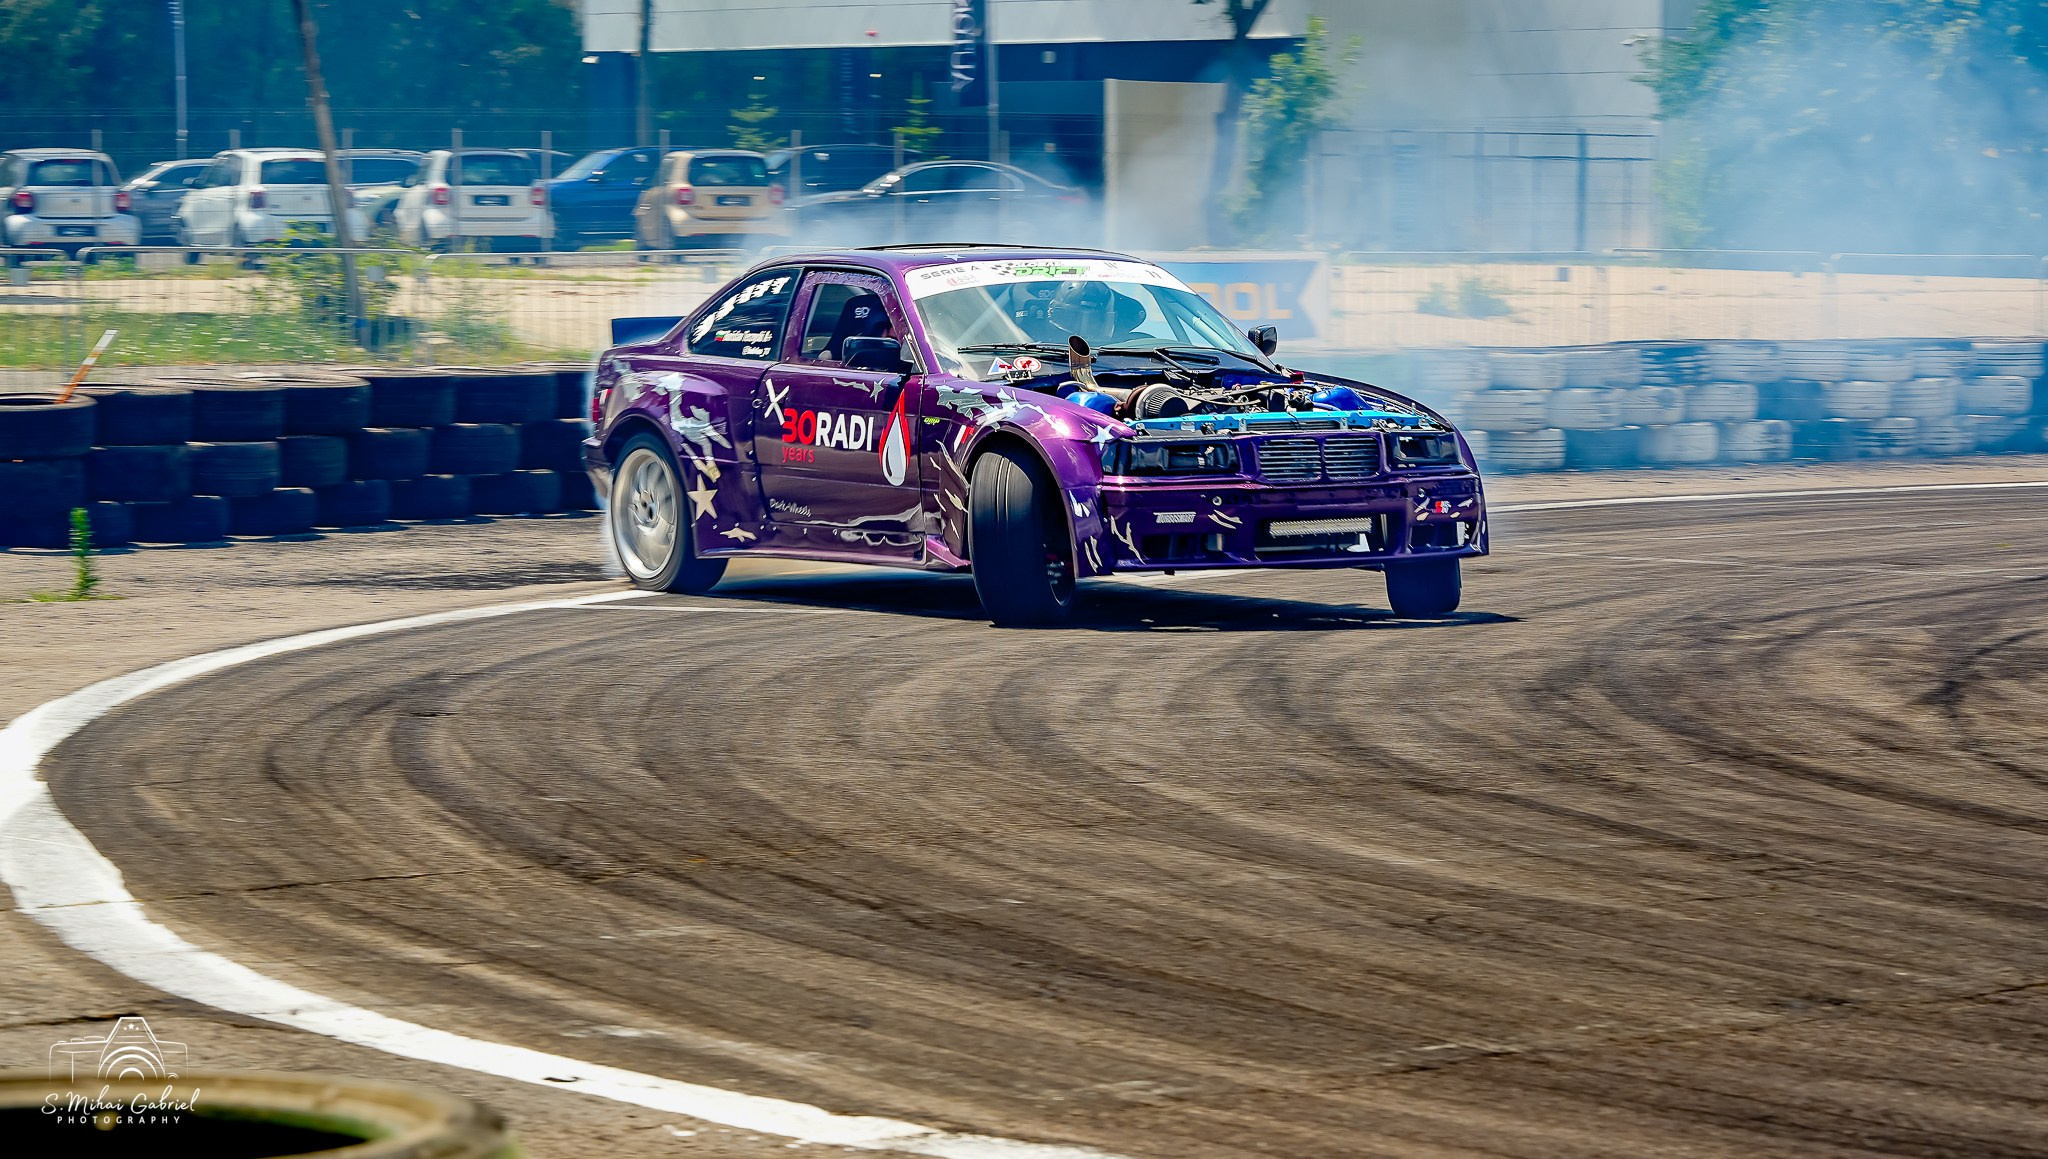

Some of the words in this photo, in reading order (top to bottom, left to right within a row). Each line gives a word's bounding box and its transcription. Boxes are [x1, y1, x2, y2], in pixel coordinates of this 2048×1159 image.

[920, 266, 966, 280] SERIE
[1012, 265, 1088, 278] DRIFT
[781, 445, 815, 463] years
